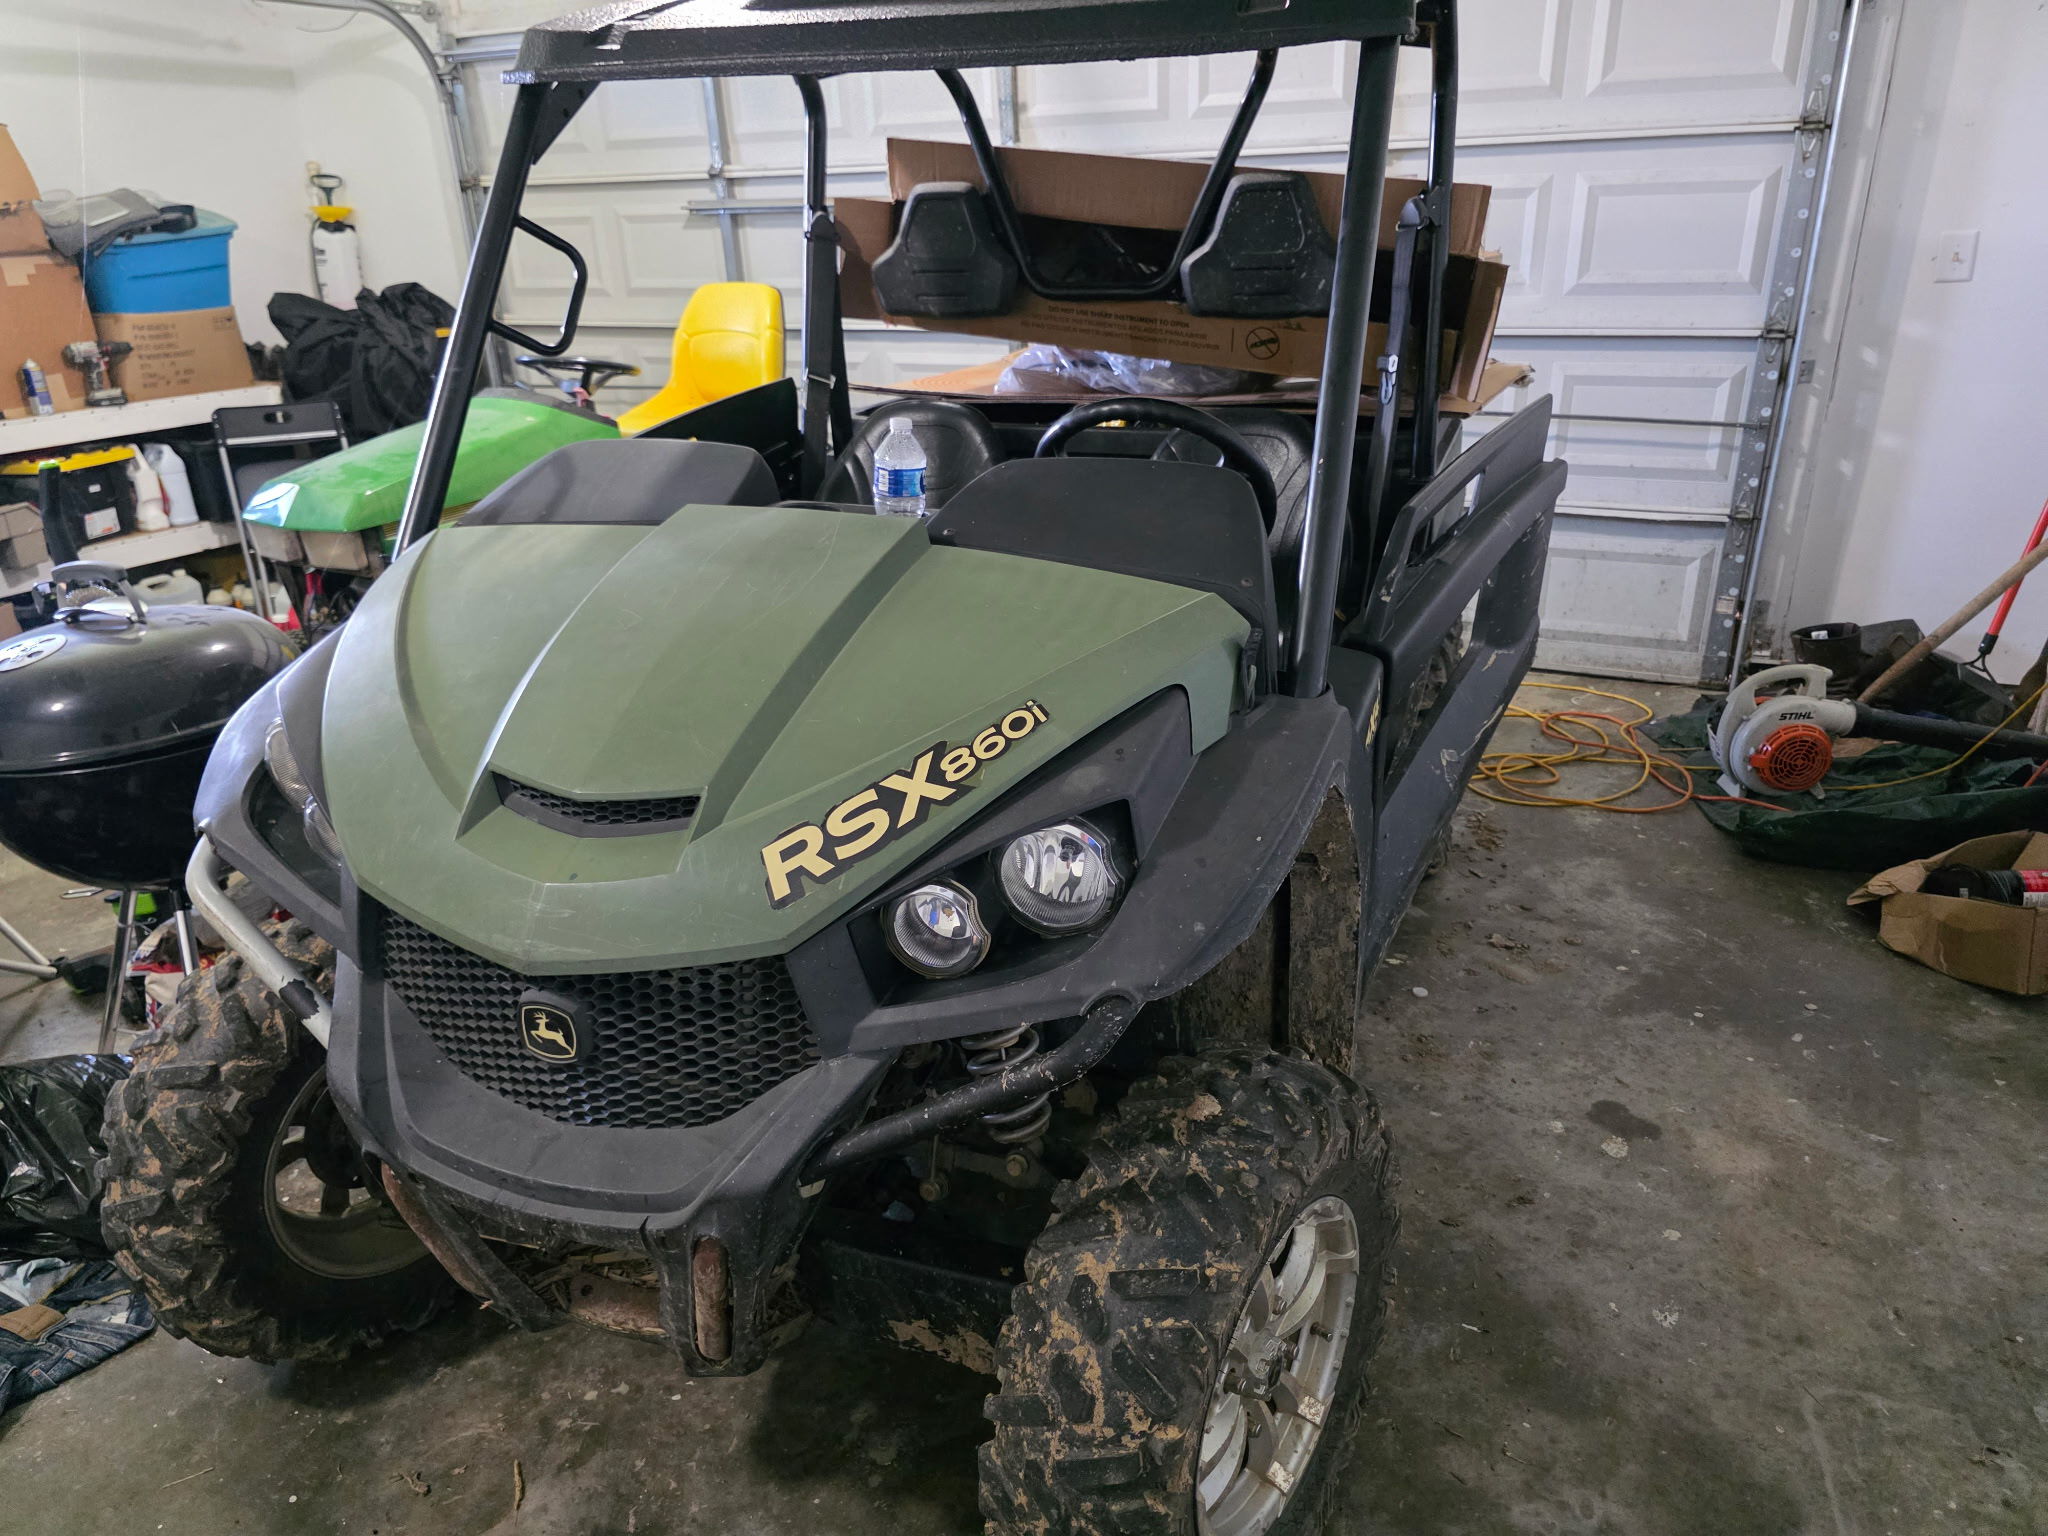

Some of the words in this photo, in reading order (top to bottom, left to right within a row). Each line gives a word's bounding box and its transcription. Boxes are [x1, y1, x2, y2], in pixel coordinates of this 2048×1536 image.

[1113, 313, 1157, 325] INSTRUMENT
[1170, 320, 1190, 328] OPEN
[1778, 711, 1815, 721] STIHL
[761, 750, 957, 902] RSX
[940, 700, 1048, 783] 860i
